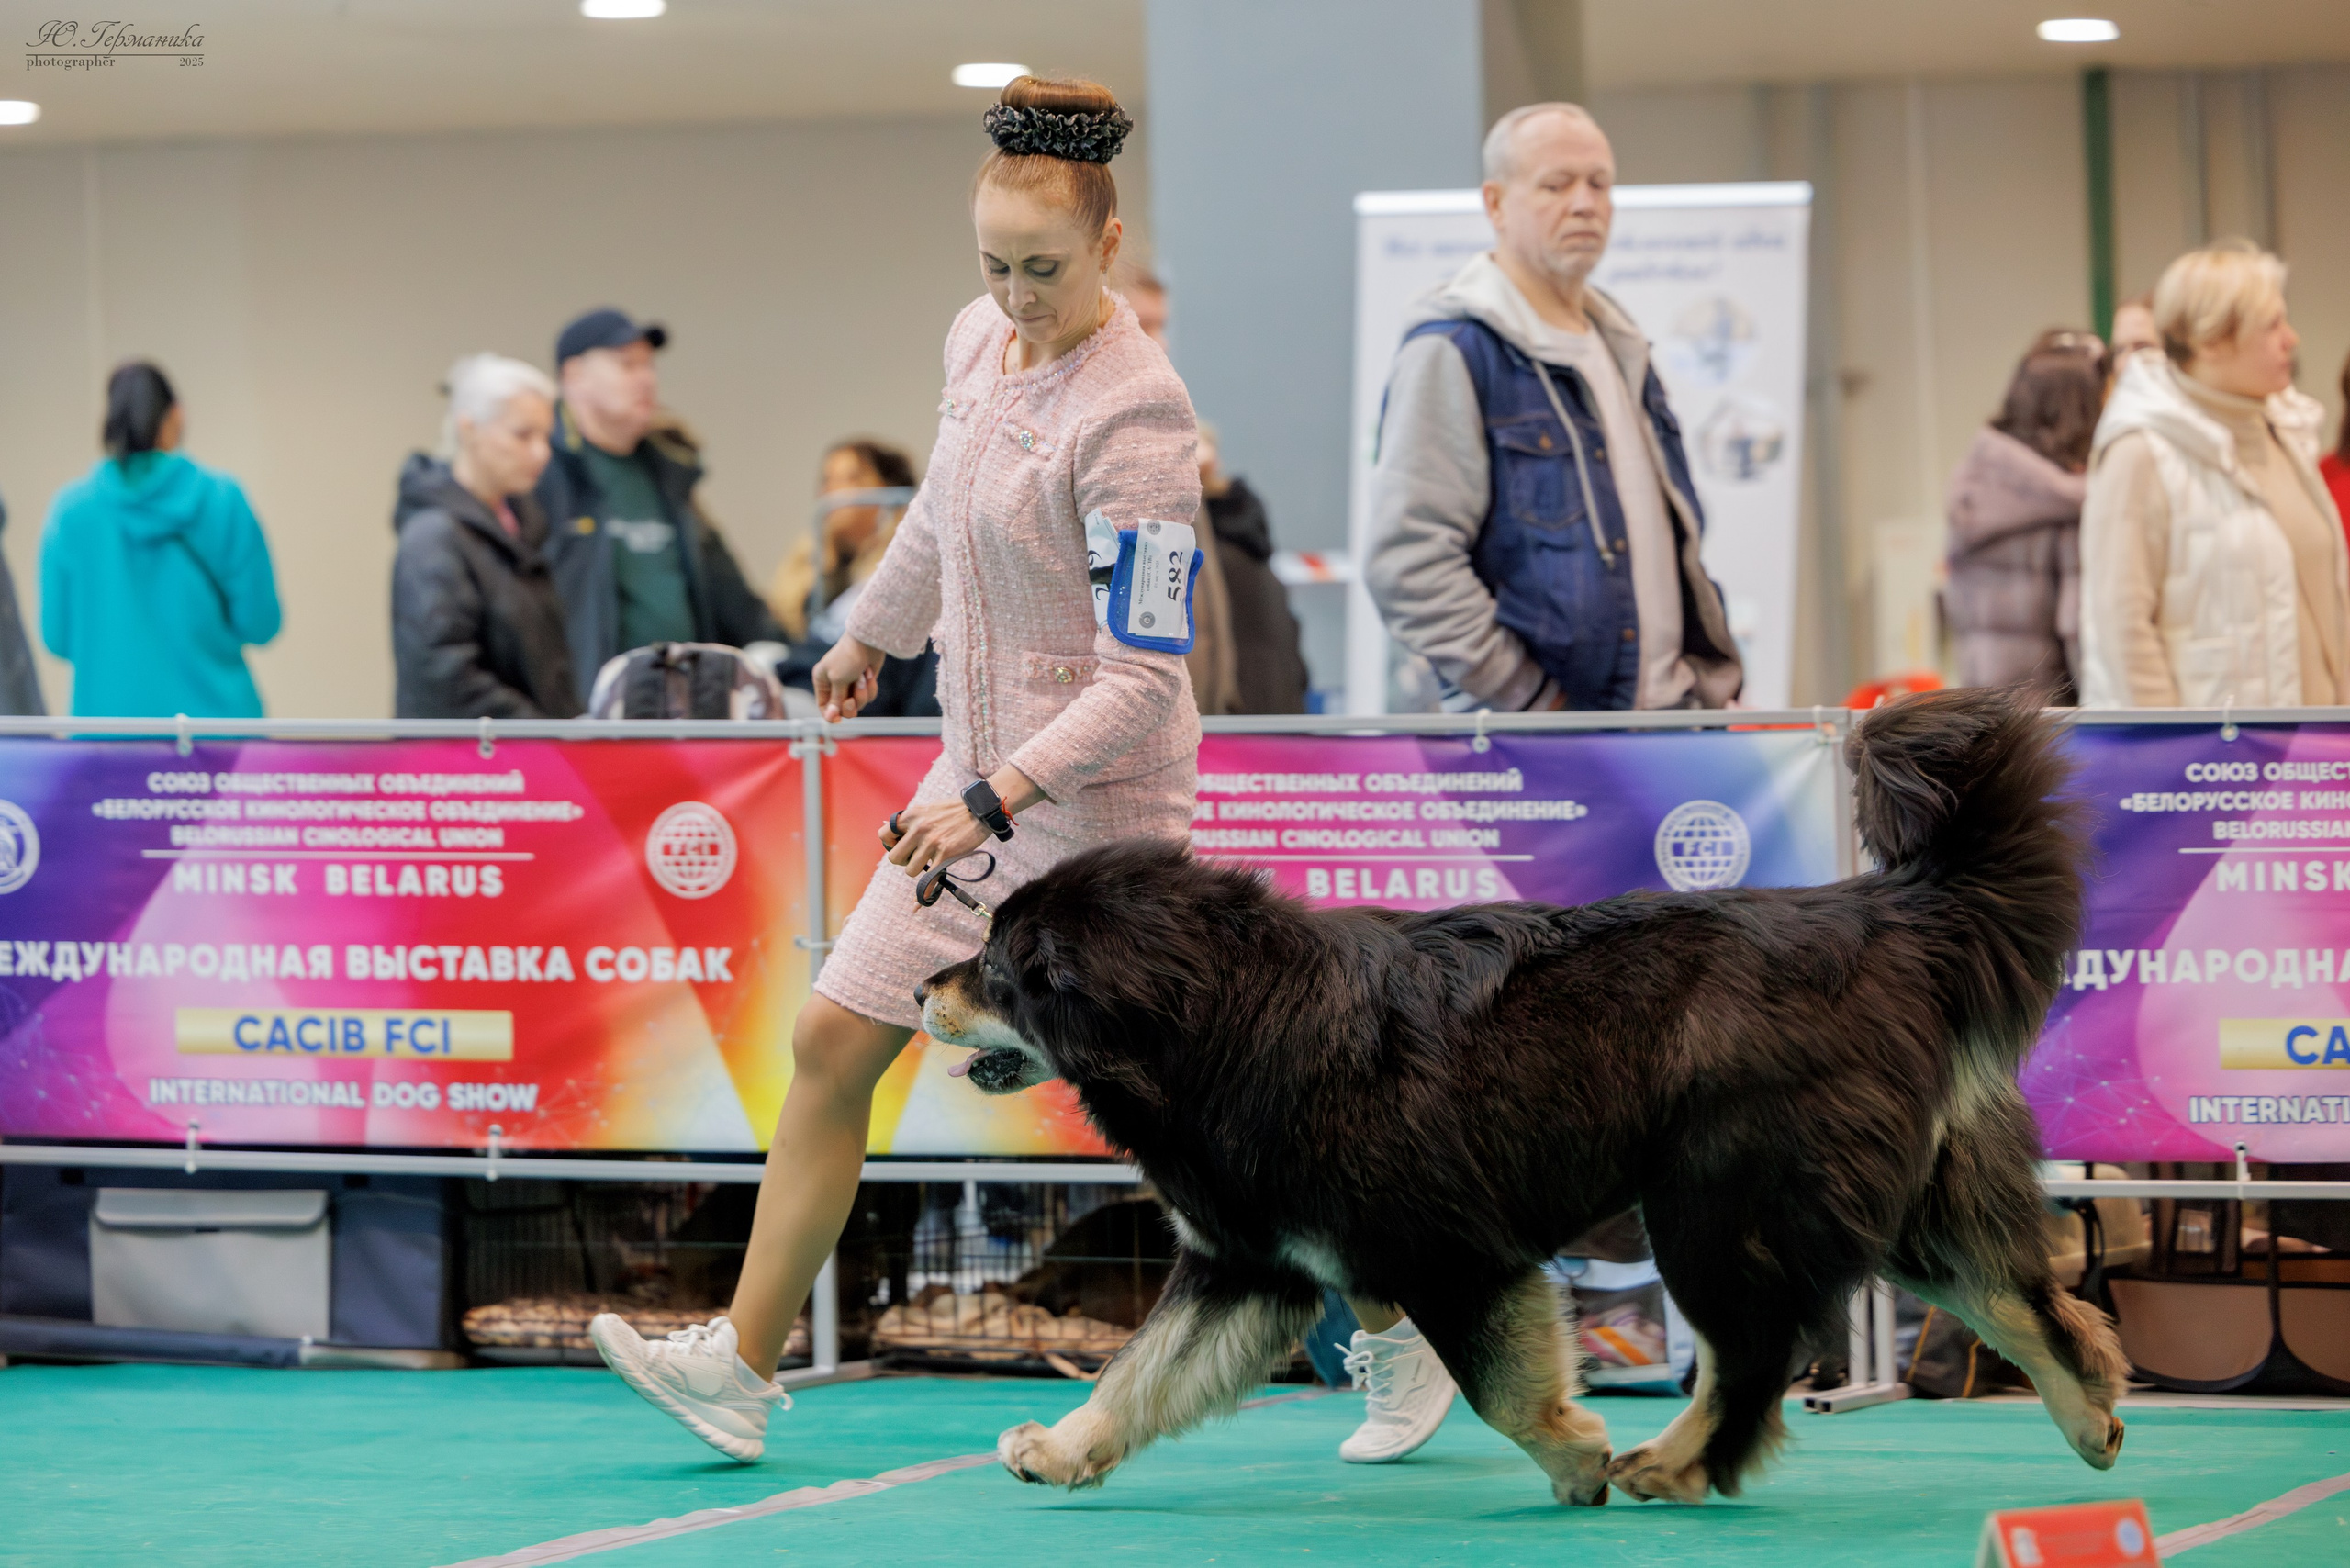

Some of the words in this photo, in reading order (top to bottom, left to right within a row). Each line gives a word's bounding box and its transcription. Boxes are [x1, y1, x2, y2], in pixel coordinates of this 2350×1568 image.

[1168, 551, 1183, 602] 582
[147, 771, 211, 793] СОЮЗ
[214, 772, 375, 795] ОБЩЕСТВЕННЫХ
[377, 769, 525, 796] ОБЪЕДИНЕНИЙ
[1197, 773, 1360, 795] БЩЕСТВЕННЫХ
[1364, 767, 1524, 795] ОБЪЕДИНЕНИЙ
[2185, 762, 2259, 783] СОЮЗ
[244, 800, 427, 822] КИНОЛОГИЧЕСКОЕ
[1218, 801, 1416, 821] КИНОЛОГИЧЕСКОЕ
[170, 825, 298, 847] BELORUSSIAN
[301, 826, 437, 848] CINOLOGICAL
[438, 827, 505, 848] UNION
[1281, 828, 1427, 849] CINOLOGICAL
[1429, 827, 1501, 849] UNION
[2212, 820, 2350, 840] BELORUSSIA
[1683, 840, 1723, 857] FCI
[173, 863, 298, 895] MINSK
[325, 864, 504, 899] BELARUS
[1305, 868, 1499, 899] BELARUS
[0, 941, 333, 982] ЕЖДУНАРОДНАЯ
[345, 944, 576, 981] ВЫСТАВКА
[585, 946, 734, 982] СОБАК
[234, 1015, 367, 1053] CACIB
[384, 1017, 452, 1054] FCI
[2286, 1025, 2350, 1065] CA
[149, 1077, 365, 1109] INTERNATIONAL
[373, 1081, 442, 1110] DOG
[447, 1082, 540, 1112] SHOW
[2188, 1096, 2350, 1124] INTERNATI
